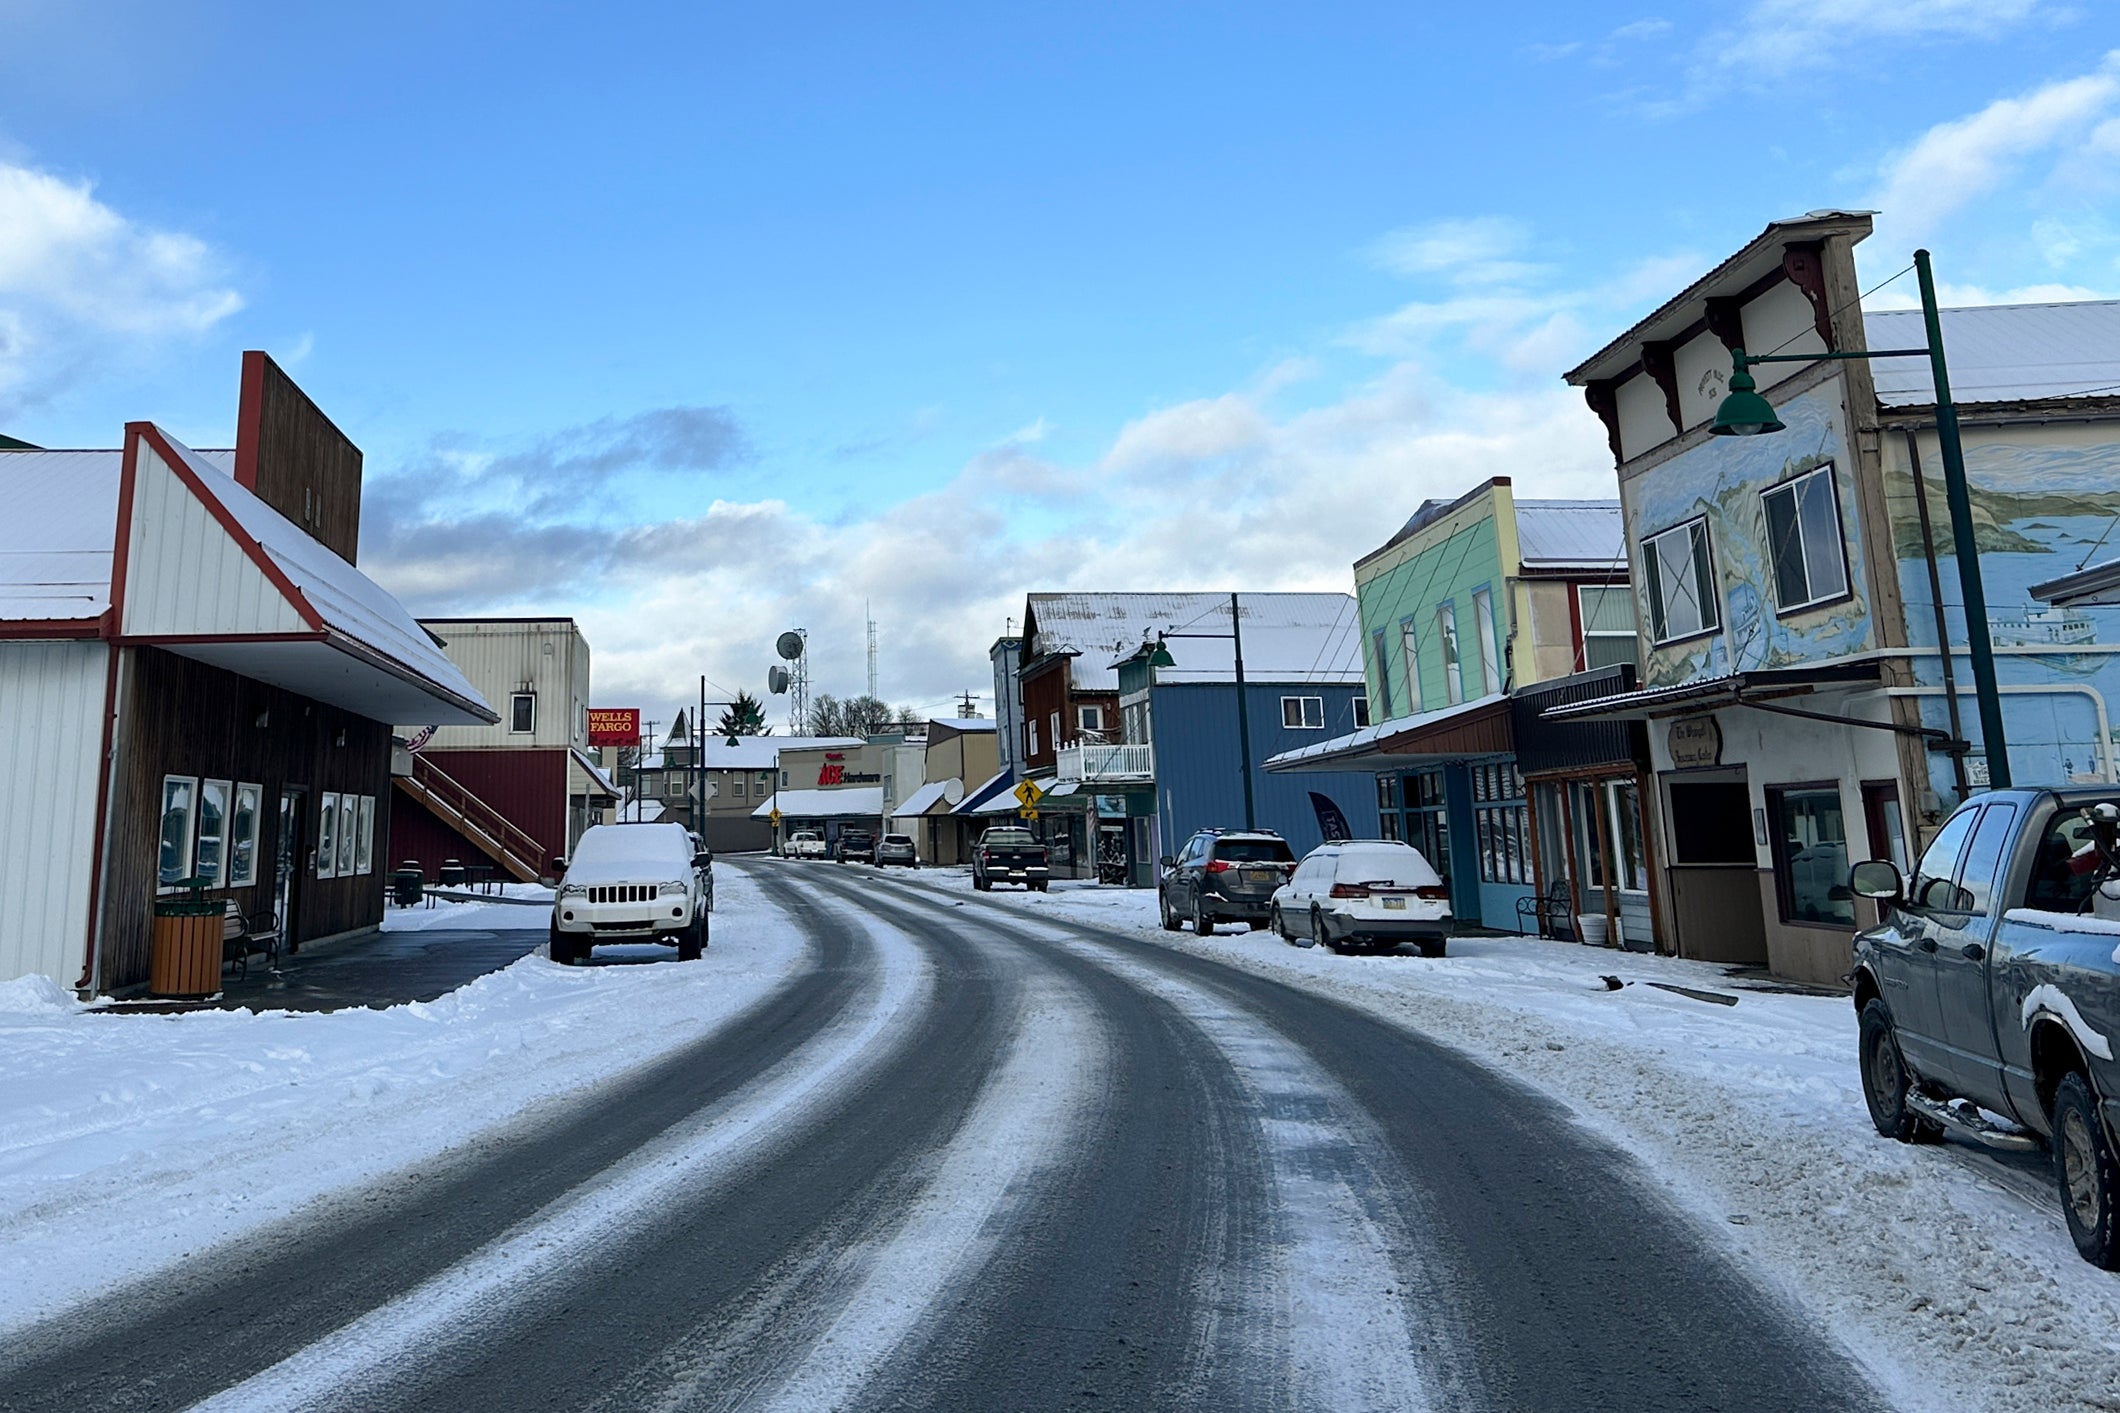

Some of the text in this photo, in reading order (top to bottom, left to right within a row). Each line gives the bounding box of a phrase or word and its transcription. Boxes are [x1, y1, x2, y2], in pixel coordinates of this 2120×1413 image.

[590, 712, 632, 722] WELLS
[590, 722, 632, 732] FARGO
[818, 764, 844, 785] ACE
